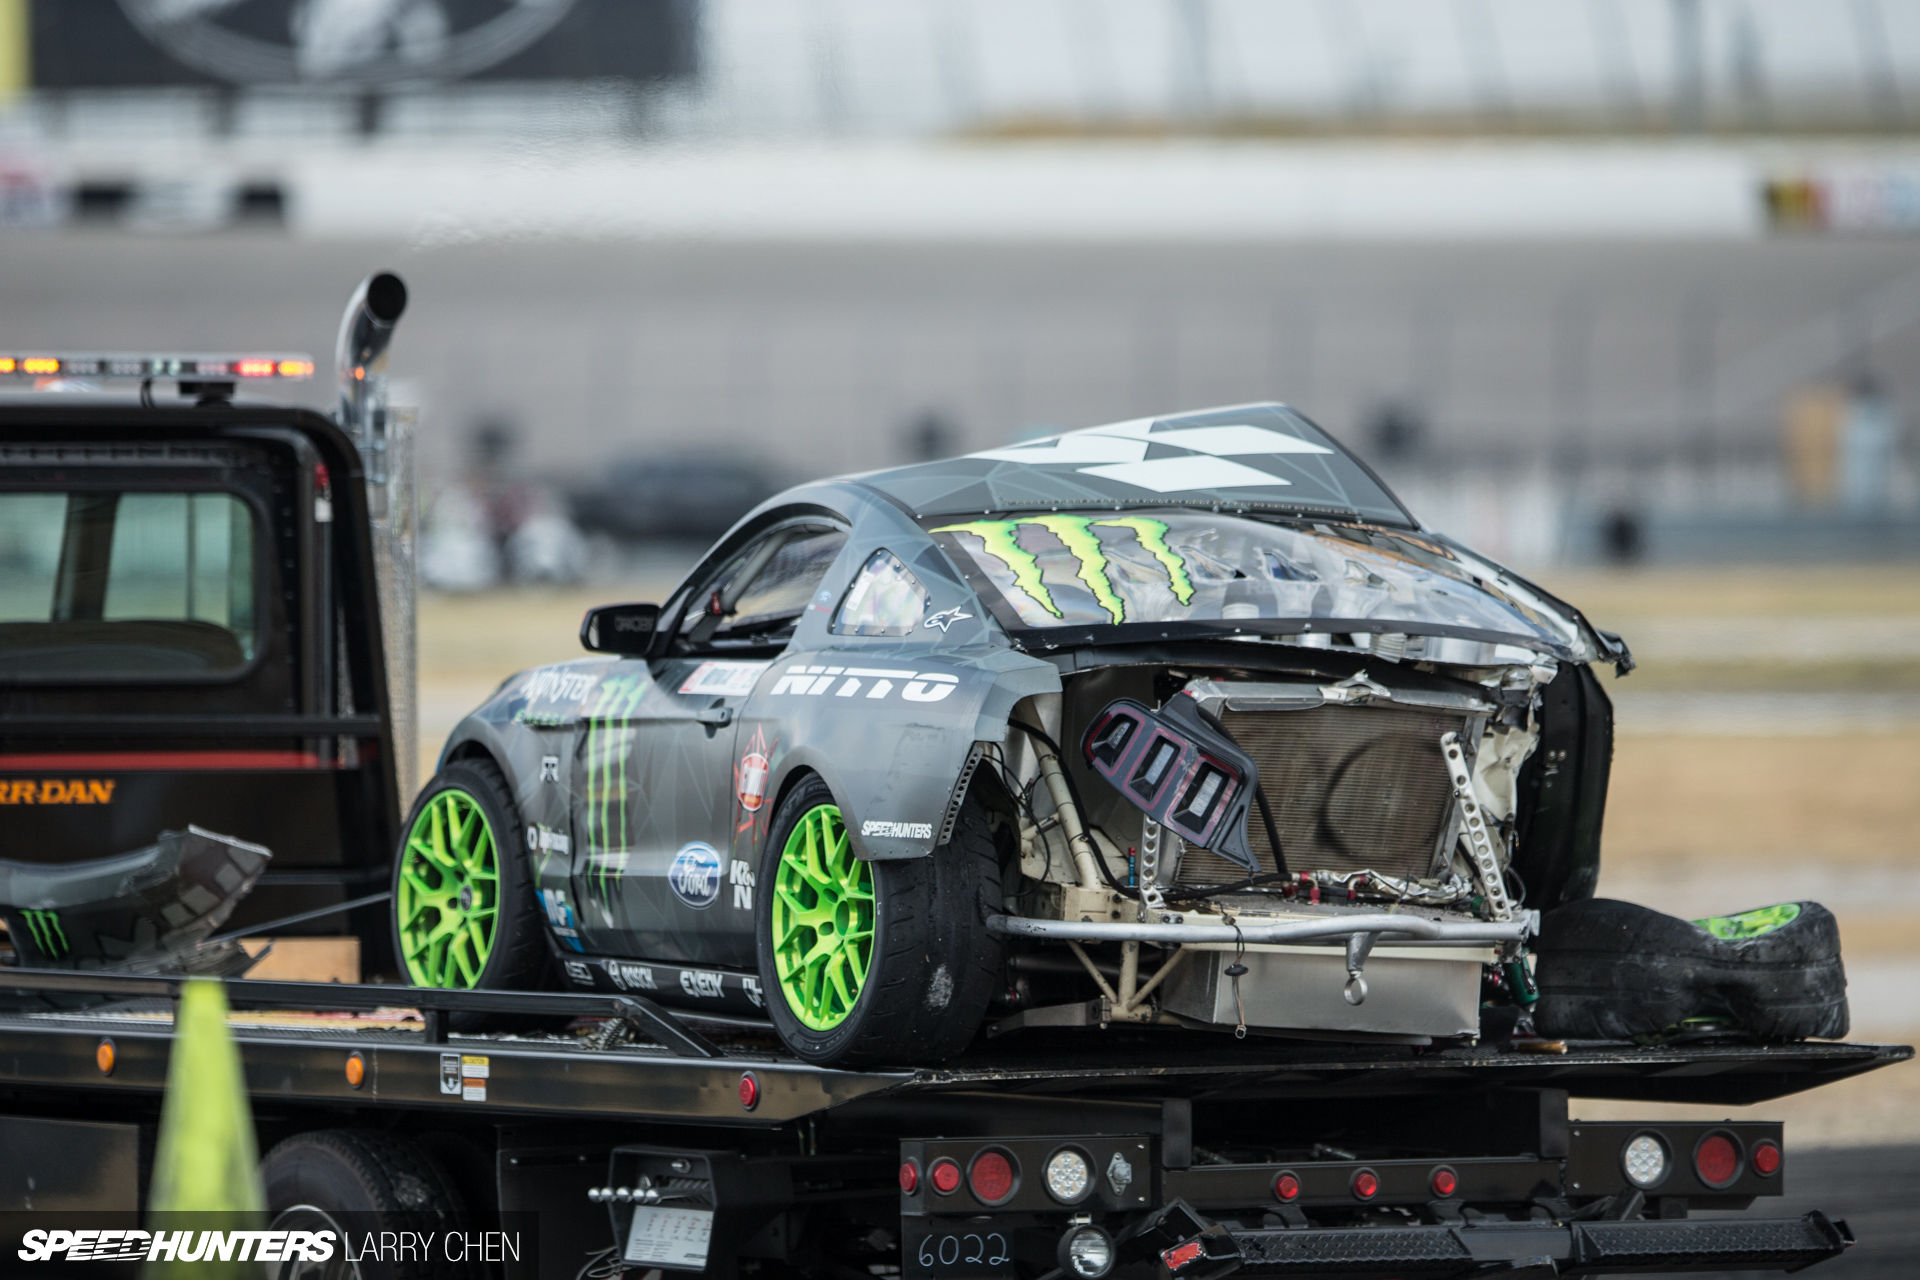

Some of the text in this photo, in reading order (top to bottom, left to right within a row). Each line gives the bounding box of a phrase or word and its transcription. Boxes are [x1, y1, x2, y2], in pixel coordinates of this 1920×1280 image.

[770, 665, 959, 702] NITTO
[861, 820, 933, 839] SPEEDHUNTERS
[678, 851, 713, 897] Ford
[621, 965, 658, 989] BOSCH
[680, 970, 725, 998] EXEDY
[918, 1232, 1010, 1267] 6022
